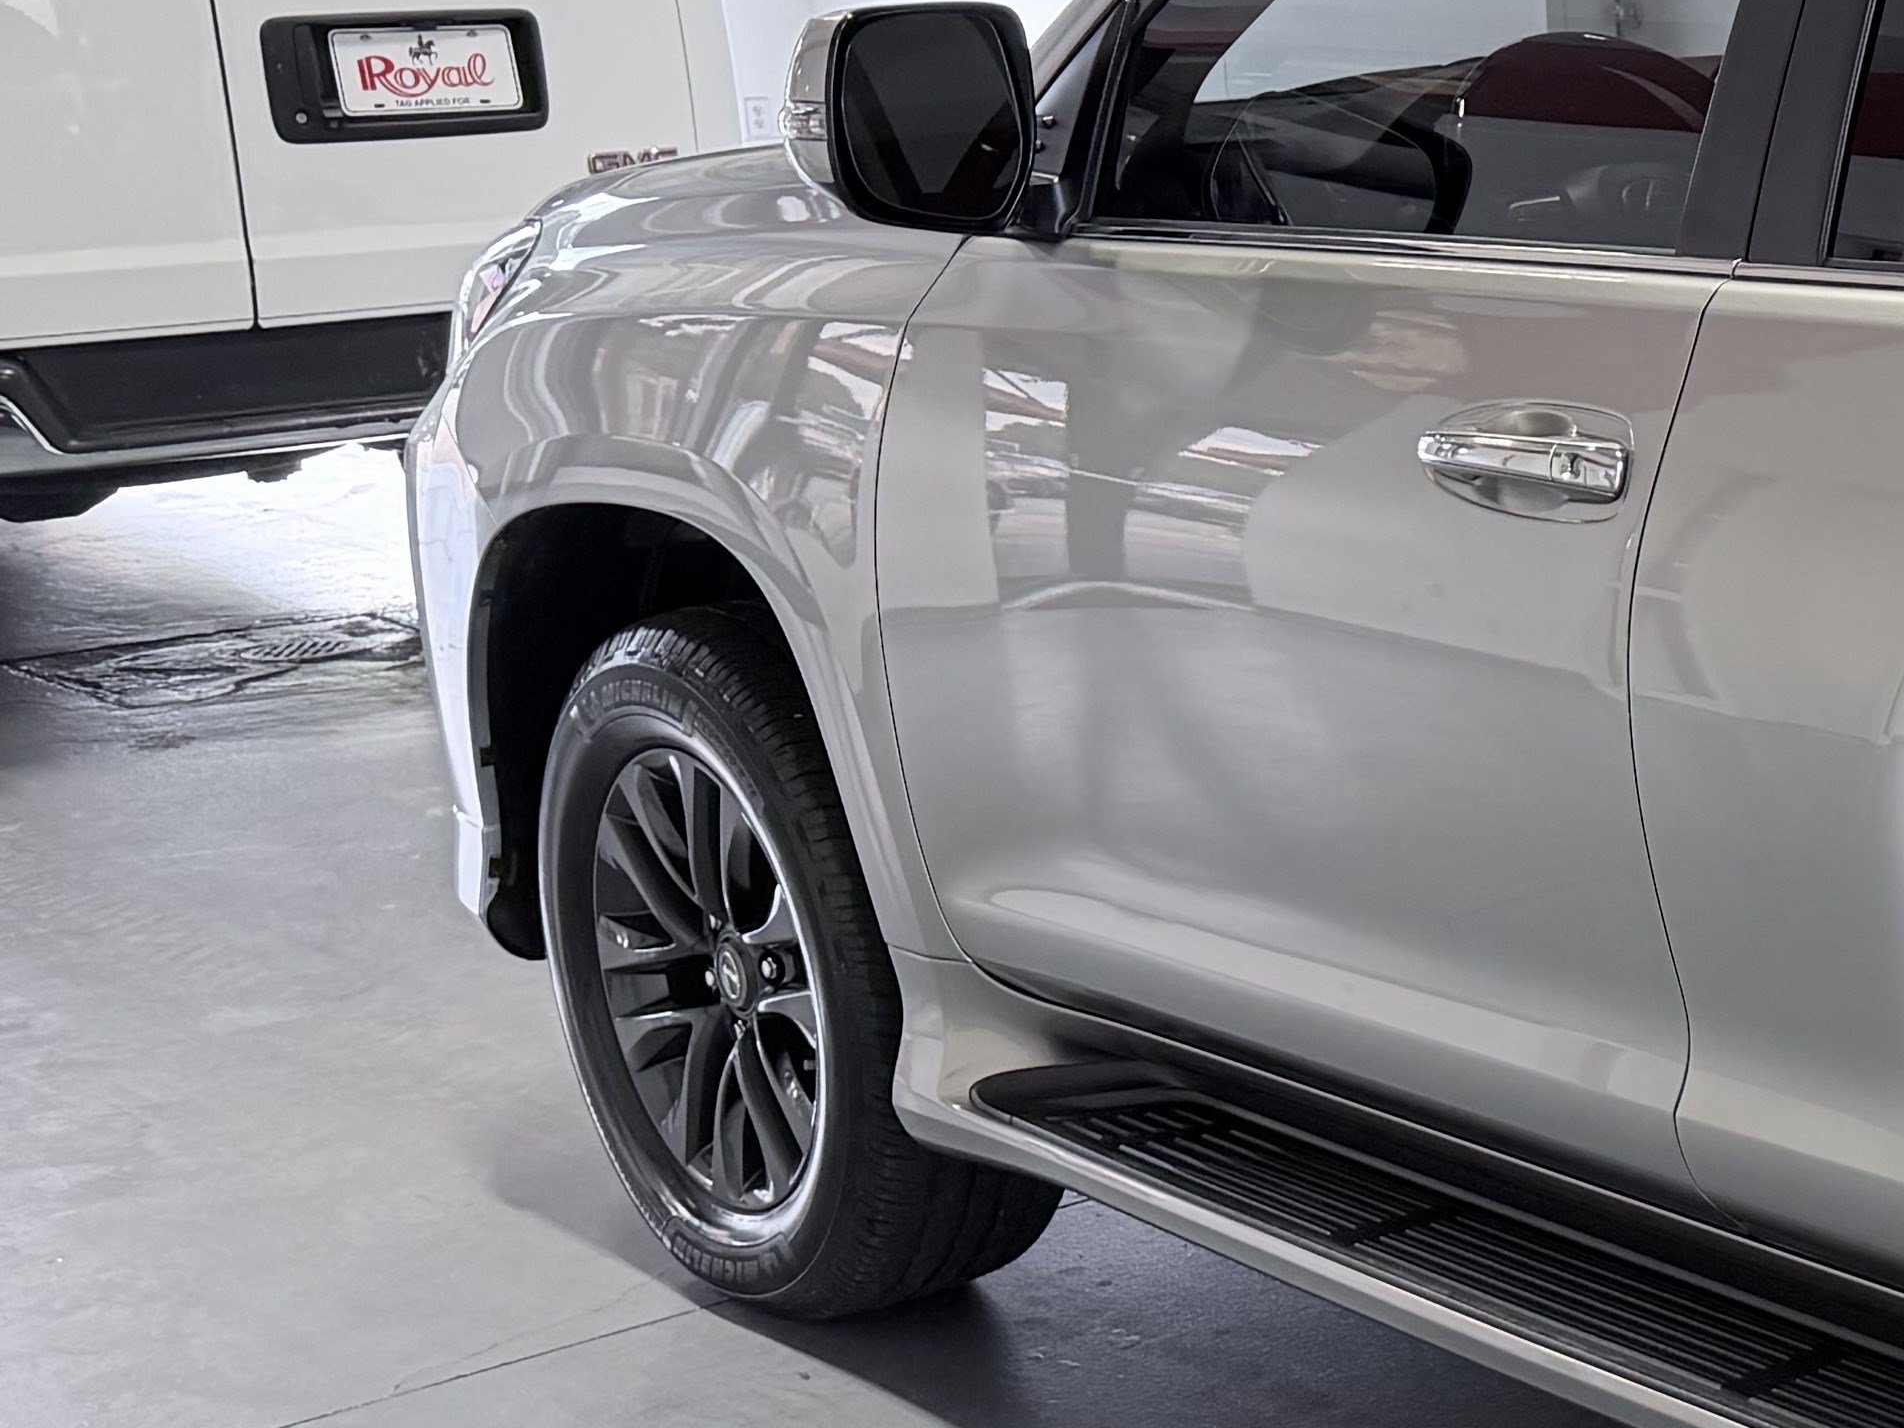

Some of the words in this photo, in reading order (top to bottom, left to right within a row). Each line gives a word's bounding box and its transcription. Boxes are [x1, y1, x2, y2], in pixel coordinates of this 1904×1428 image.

[356, 52, 495, 98] Royal
[395, 99, 414, 108] TAG
[415, 97, 451, 107] APPLIED
[452, 96, 470, 105] FOR
